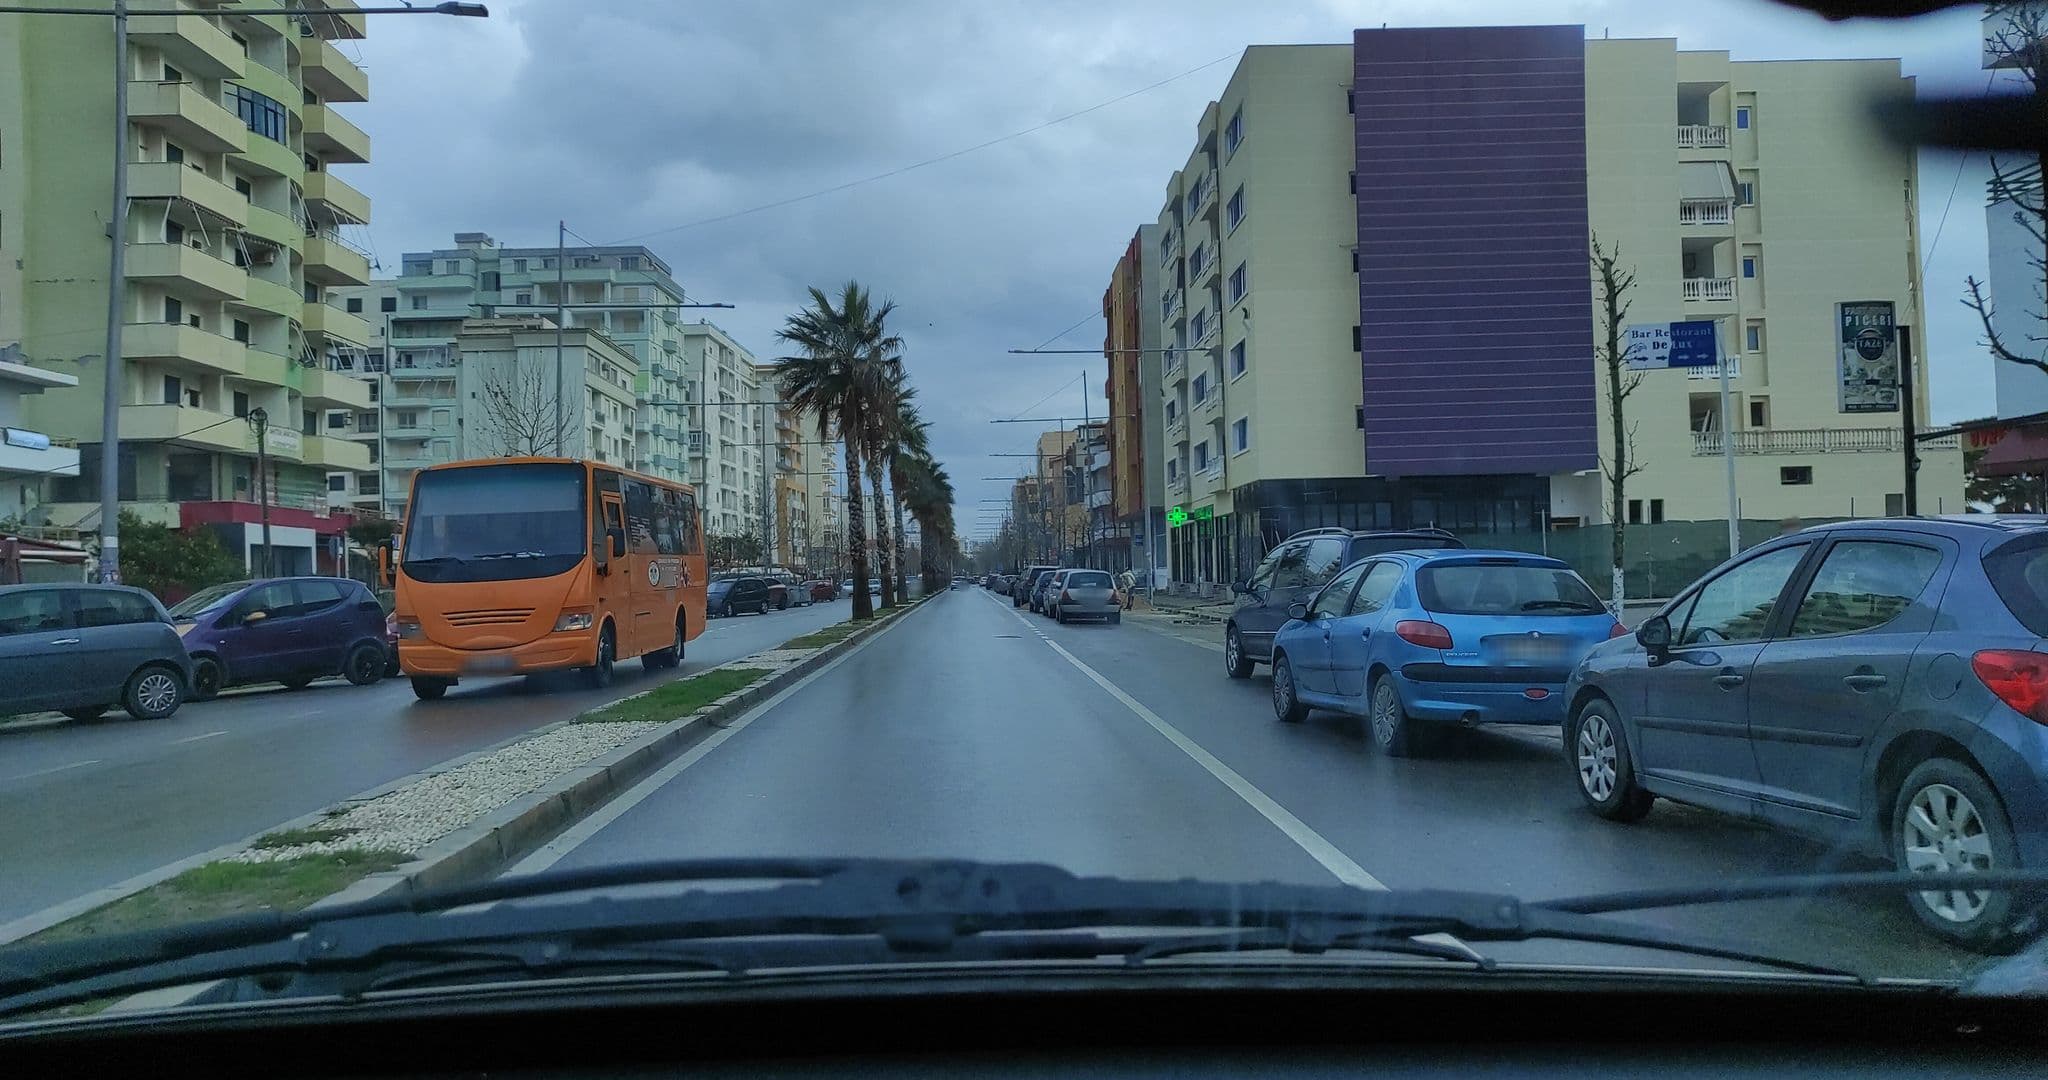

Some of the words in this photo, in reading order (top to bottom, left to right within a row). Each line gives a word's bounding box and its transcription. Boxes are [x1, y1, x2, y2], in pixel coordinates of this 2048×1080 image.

[1631, 330, 1651, 339] Bar
[1655, 327, 1712, 337] Restorant
[1652, 341, 1667, 350] De
[1671, 340, 1694, 350] Lux
